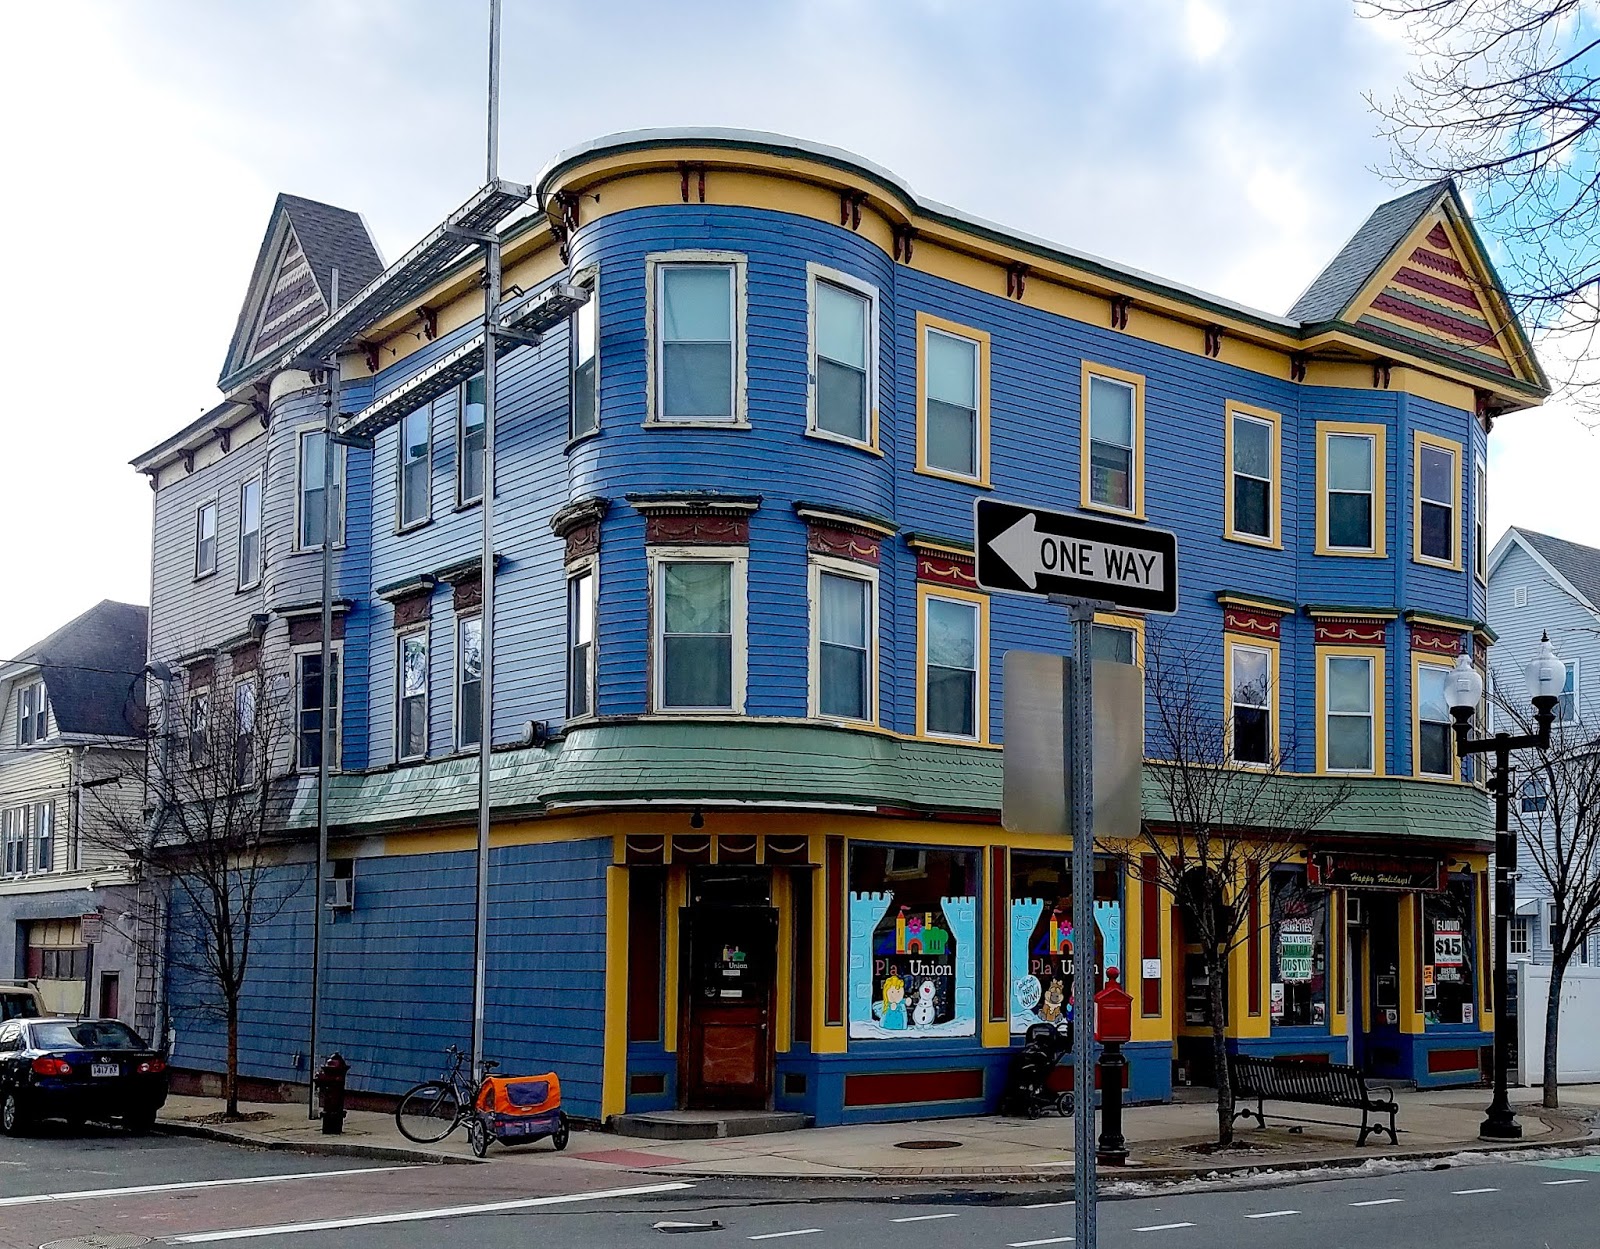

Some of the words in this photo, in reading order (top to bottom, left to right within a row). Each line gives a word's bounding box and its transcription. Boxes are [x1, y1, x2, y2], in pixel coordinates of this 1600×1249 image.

[1041, 538, 1094, 576] ONE
[1104, 548, 1156, 584] WAY
[1350, 872, 1374, 885] Happy
[1377, 873, 1413, 886] Holidays!
[1436, 920, 1460, 931] E-LIQUID
[1435, 937, 1461, 956] $15
[910, 959, 953, 976] Union
[1022, 986, 1040, 1006] NOW!
